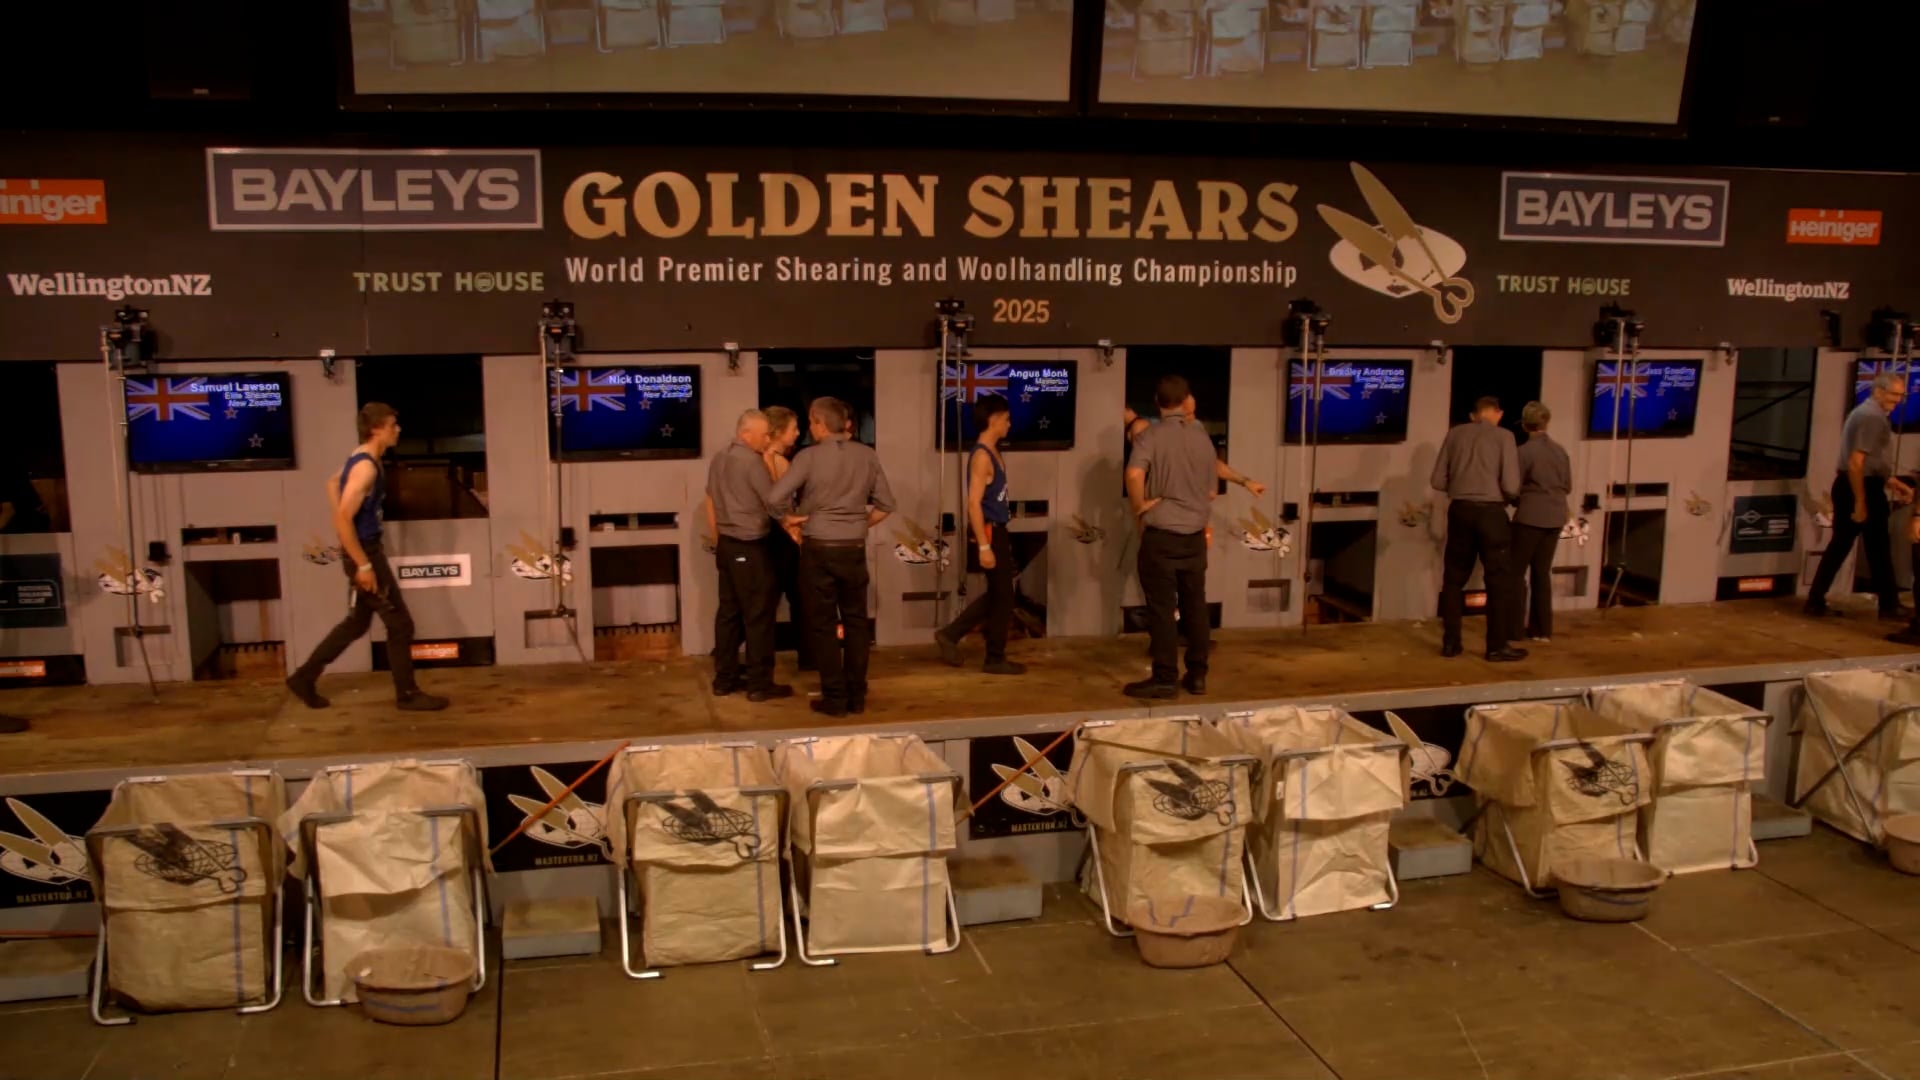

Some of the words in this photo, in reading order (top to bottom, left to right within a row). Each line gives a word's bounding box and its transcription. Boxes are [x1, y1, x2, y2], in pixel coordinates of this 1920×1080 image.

[232, 168, 519, 211] BAYLEYS
[563, 171, 939, 239] GOLDEN
[963, 175, 1299, 243] SHEARS
[1516, 189, 1712, 231] BAYLEYS
[1790, 210, 1878, 242] Heiniger
[353, 272, 443, 292] TRUST
[455, 271, 545, 293] HOUSE
[565, 256, 644, 283] World
[658, 256, 763, 282] Premier
[775, 256, 892, 286] Shearing
[903, 257, 947, 281] and
[958, 257, 1122, 286] Woolhandling
[1133, 258, 1297, 288] Championship
[7, 272, 212, 301] WellingtonNZ
[1497, 274, 1560, 293] TRUST
[1567, 277, 1630, 296] HOUSE
[1727, 278, 1850, 302] WellingtonNZ
[993, 299, 1050, 323] 2025
[608, 375, 632, 384] Nick
[635, 374, 691, 384] Donaldson
[1009, 369, 1040, 380] Angus
[1042, 369, 1068, 378] Monk
[191, 382, 233, 393] Samuel
[235, 382, 280, 392] Lawson
[401, 566, 459, 577] BAYLEYS
